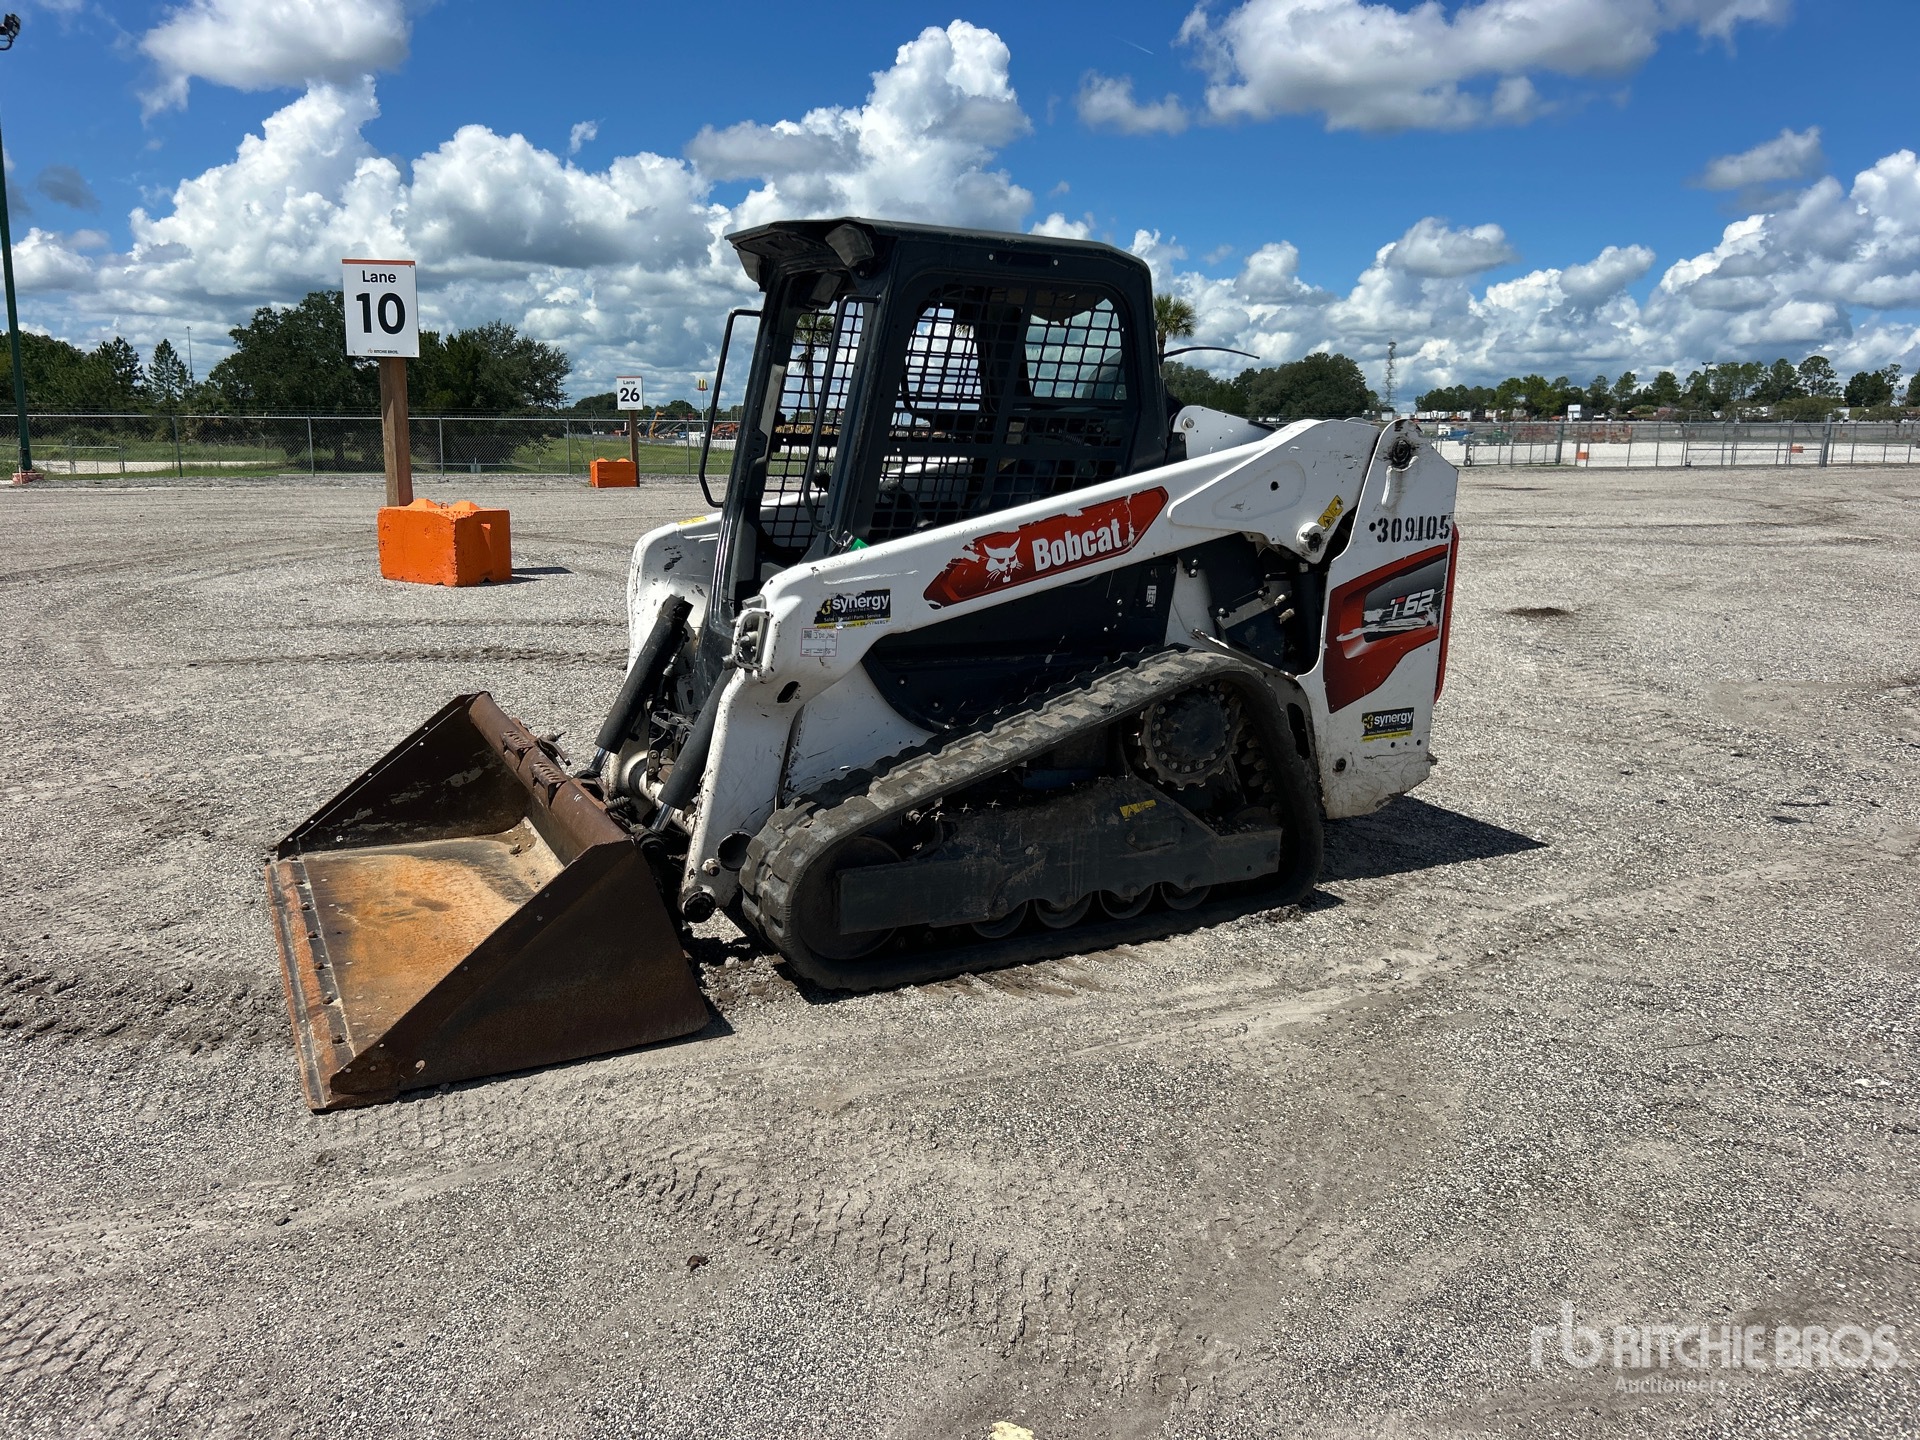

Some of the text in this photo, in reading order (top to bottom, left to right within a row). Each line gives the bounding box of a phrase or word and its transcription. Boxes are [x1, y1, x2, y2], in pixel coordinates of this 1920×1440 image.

[362, 270, 396, 283] Lane
[356, 293, 405, 334] 10
[620, 387, 640, 402] 26
[1376, 515, 1450, 543] 309105
[1032, 518, 1122, 572] Bobcat
[832, 594, 890, 613] synergy
[1374, 711, 1413, 727] synergy
